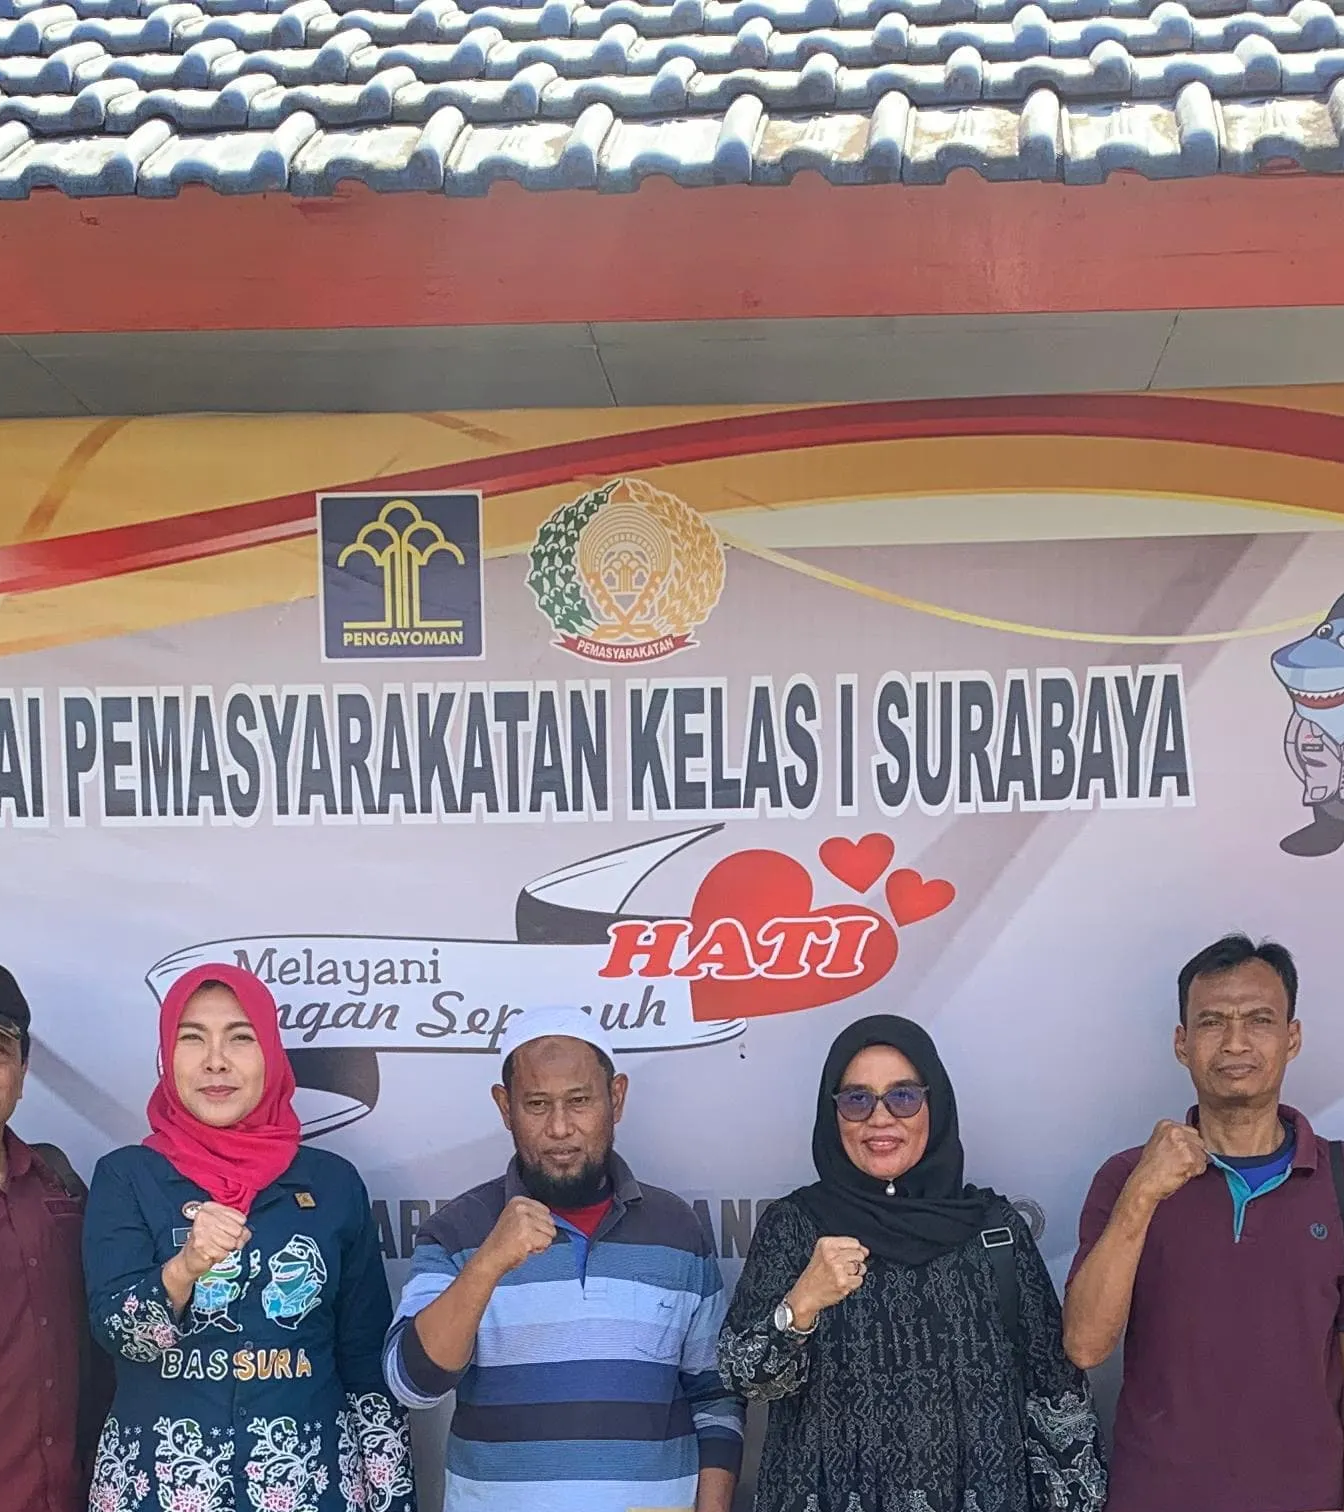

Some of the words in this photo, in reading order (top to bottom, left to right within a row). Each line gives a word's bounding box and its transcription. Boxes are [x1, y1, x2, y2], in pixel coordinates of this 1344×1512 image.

[343, 630, 464, 647] PENGAYOMAN
[576, 637, 675, 661] PEMASYARAKATAN
[61, 688, 608, 820] PEMASYARAKATAN
[627, 681, 819, 811] KELAS
[839, 682, 855, 807] I
[874, 672, 1191, 809] SURABAYA
[232, 947, 443, 996] Melayani
[597, 917, 880, 979] HATI
[415, 984, 667, 1049] Sepuh
